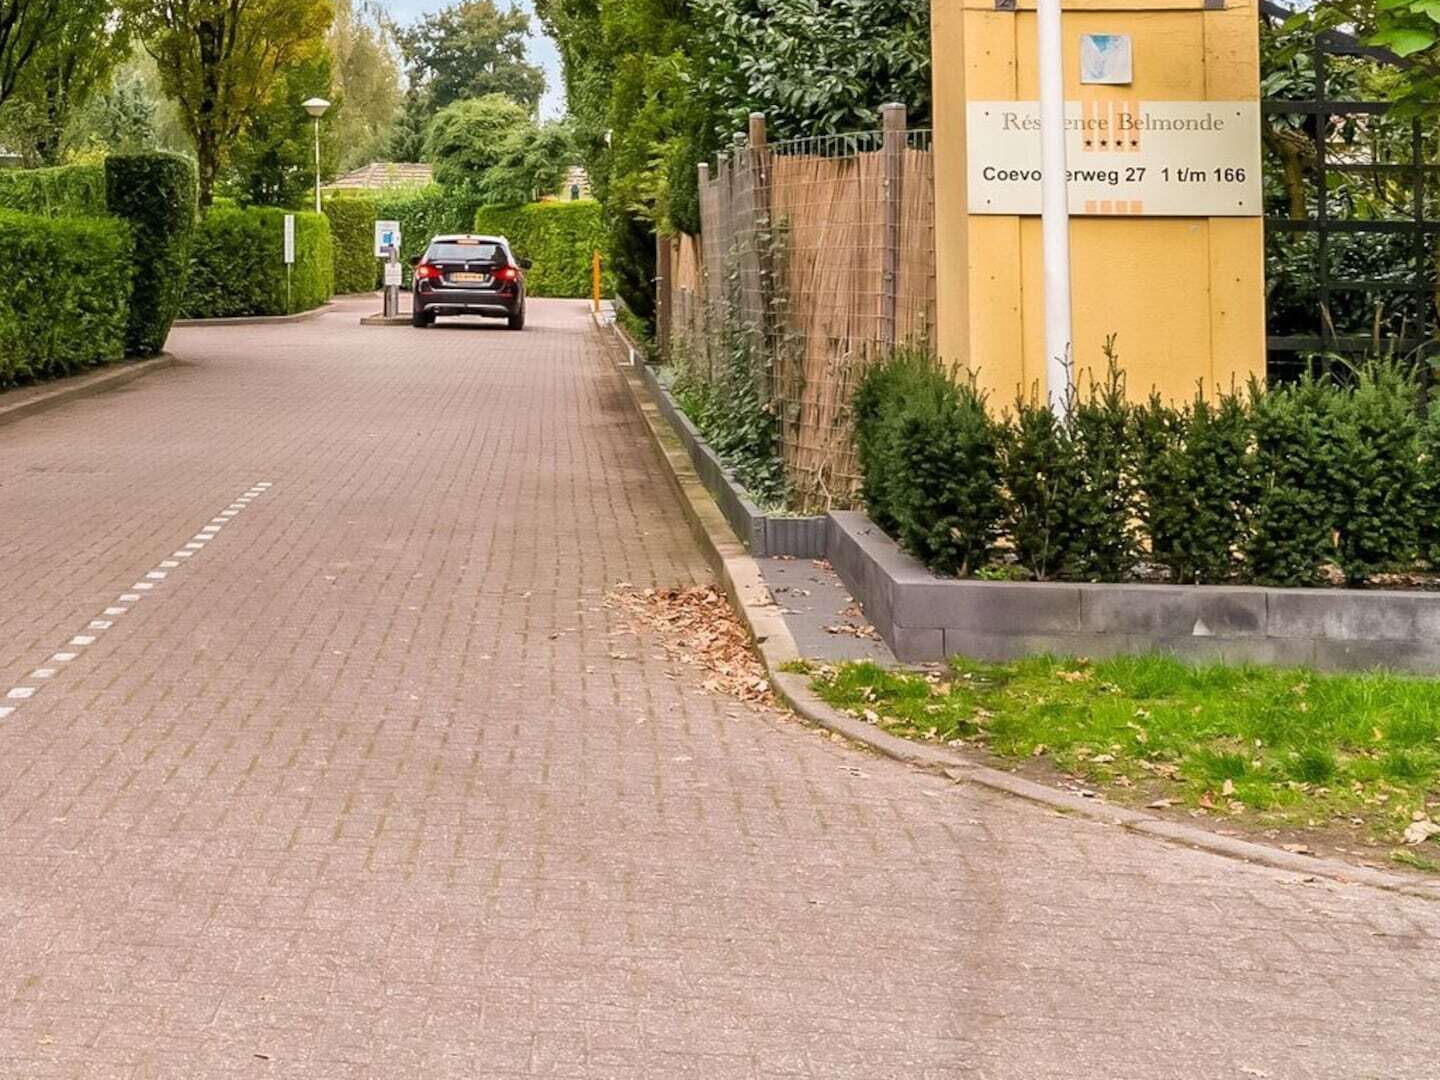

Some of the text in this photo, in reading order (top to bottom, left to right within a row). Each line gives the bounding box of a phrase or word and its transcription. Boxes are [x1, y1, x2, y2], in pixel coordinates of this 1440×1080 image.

[1001, 111, 1224, 131] Résence Belmonde
[982, 166, 1246, 185] Coevoerweg 27 1 t/m 166
